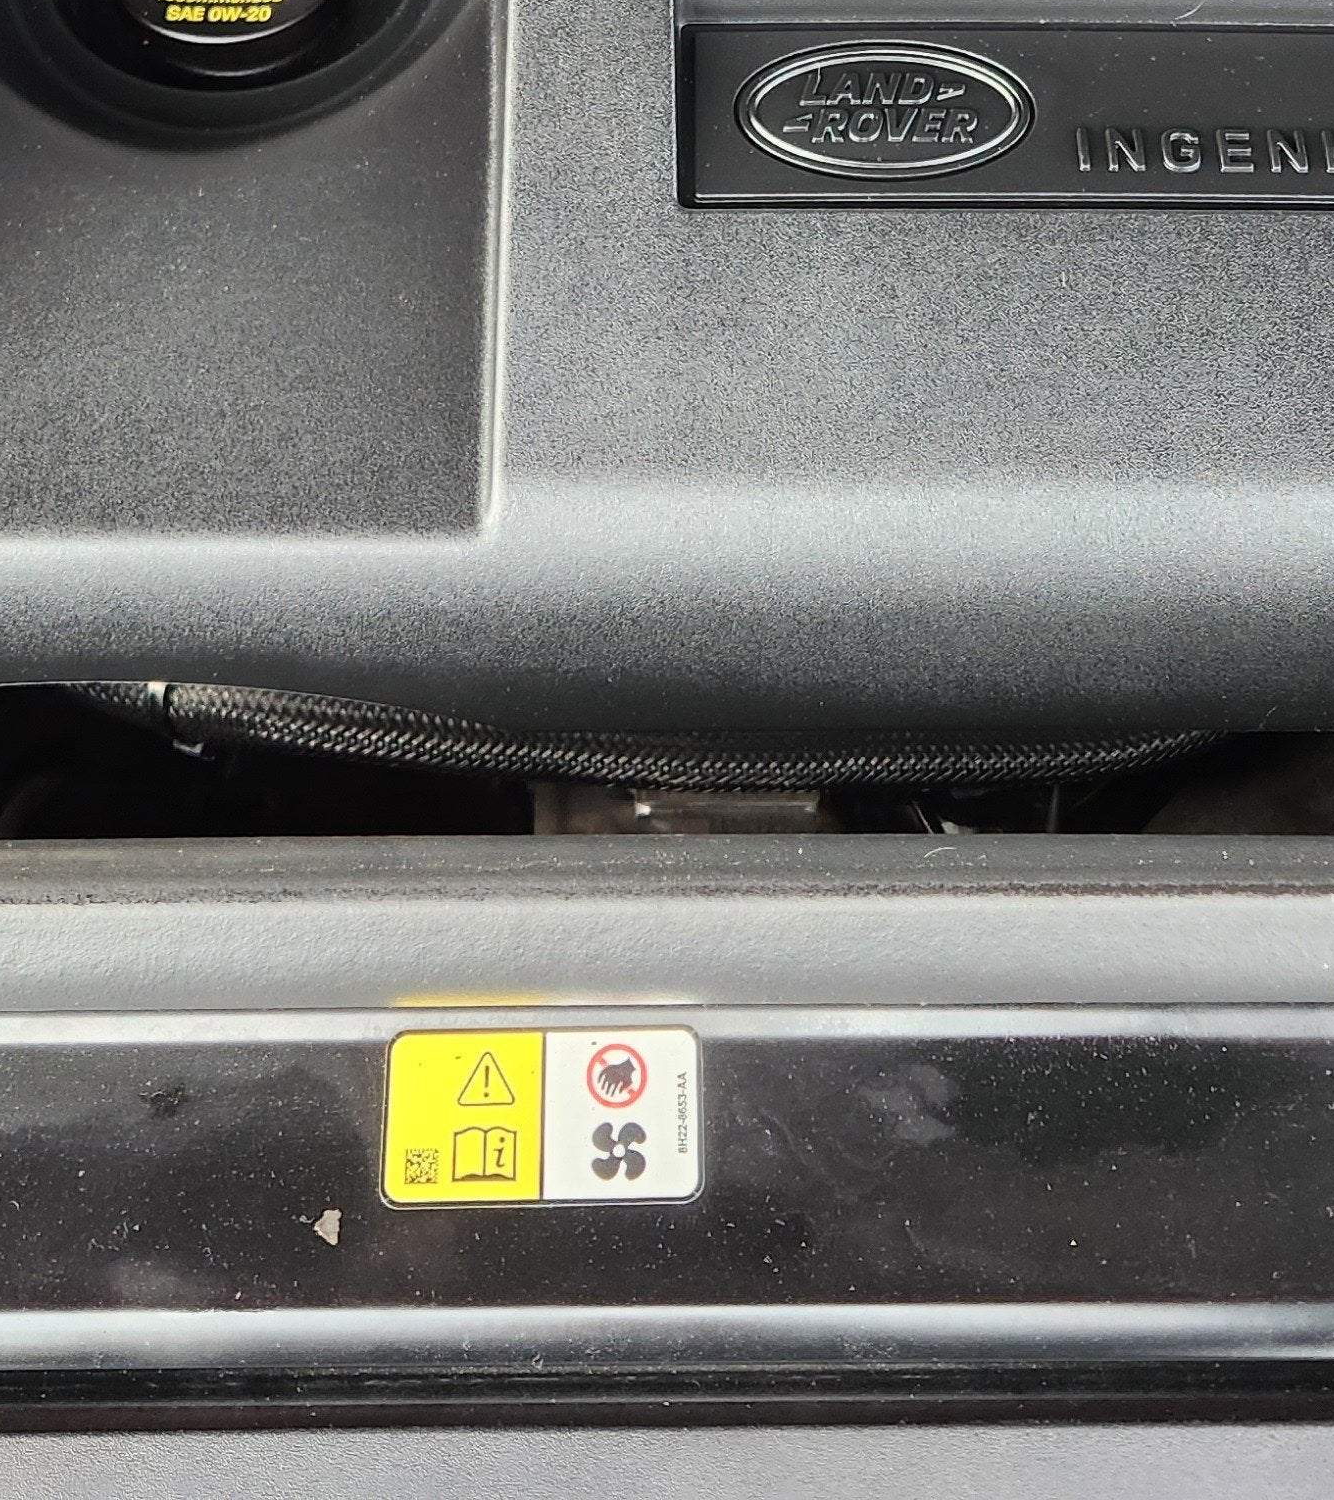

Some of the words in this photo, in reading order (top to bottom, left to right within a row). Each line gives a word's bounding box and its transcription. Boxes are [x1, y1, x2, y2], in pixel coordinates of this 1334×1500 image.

[166, 5, 205, 22] SAE
[207, 5, 272, 23] 0W-20
[798, 72, 935, 107] LAND
[810, 107, 978, 144] ROVER
